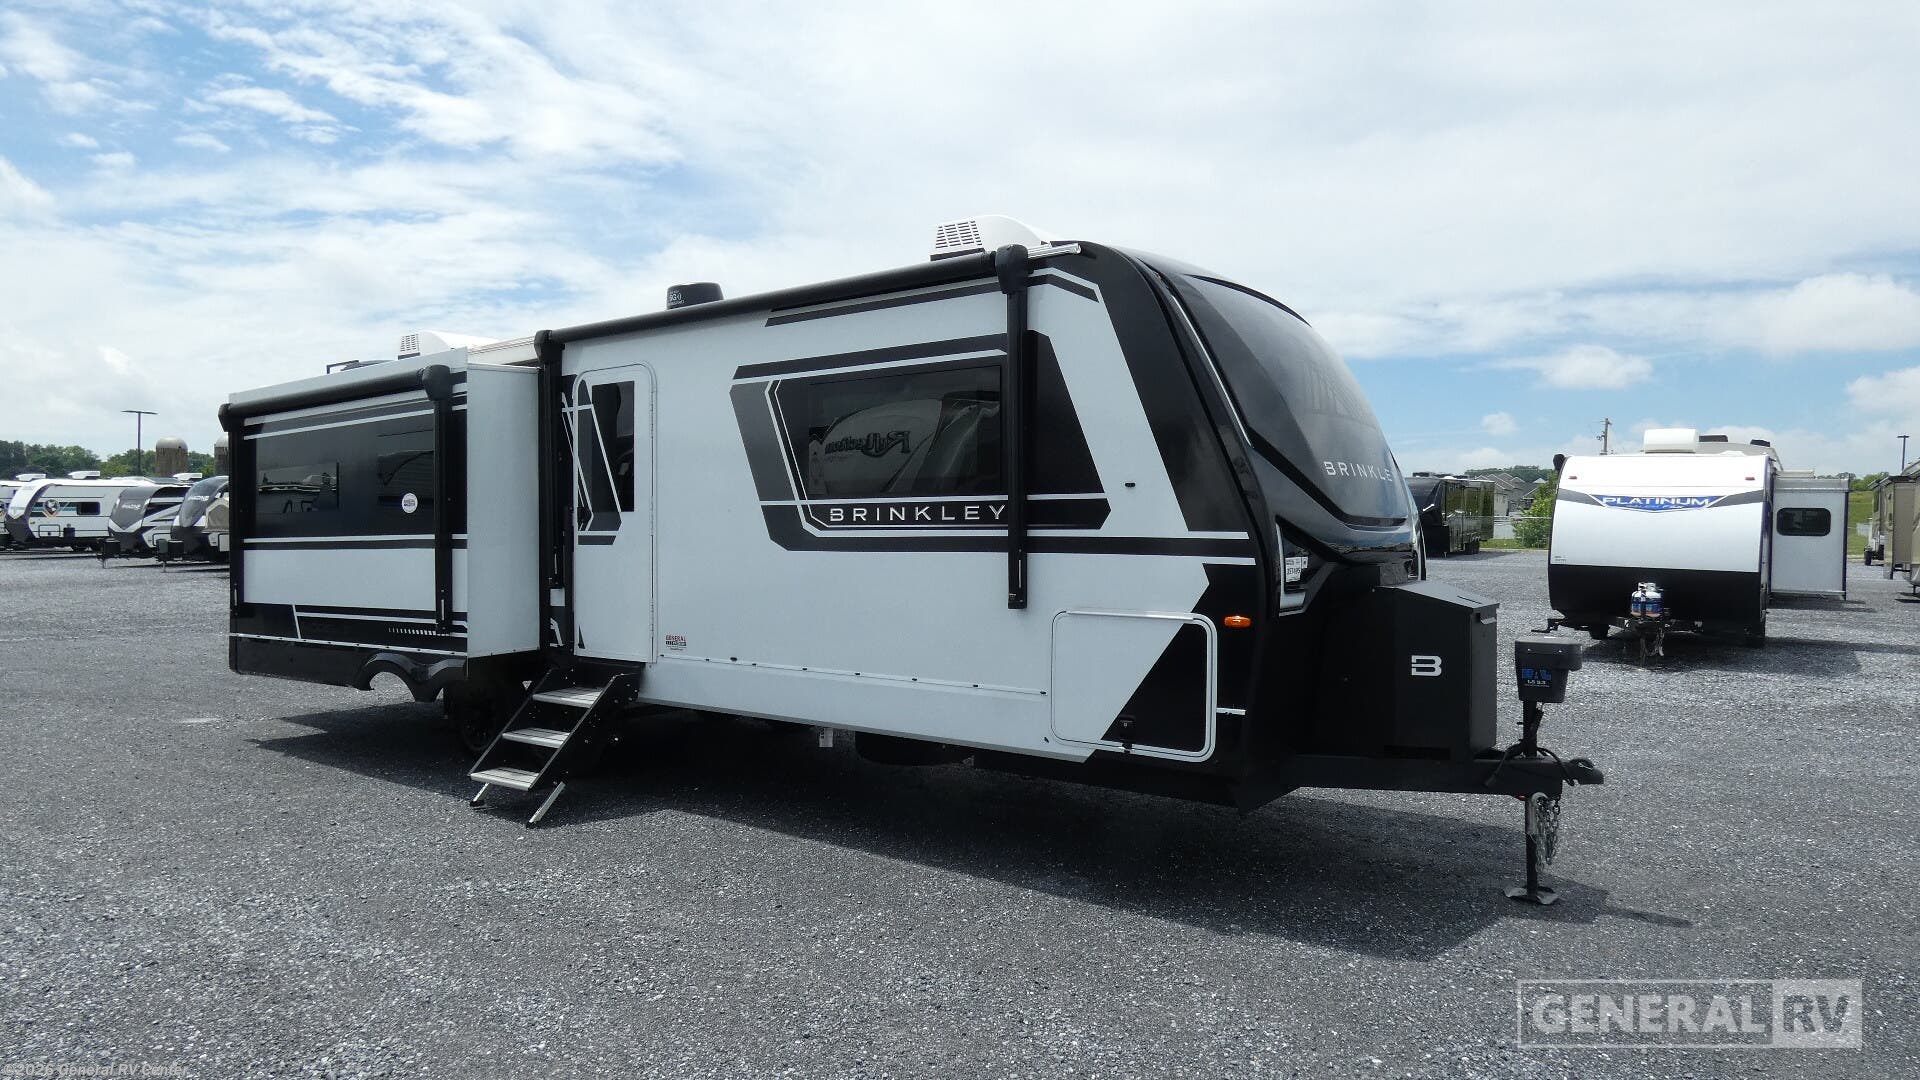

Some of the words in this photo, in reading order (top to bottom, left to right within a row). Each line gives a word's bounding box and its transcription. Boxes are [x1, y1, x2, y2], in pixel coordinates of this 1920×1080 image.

[1323, 461, 1393, 482] BRINKLE
[1602, 496, 1710, 506] PLATINUM
[829, 504, 1006, 522] BRINKLEY
